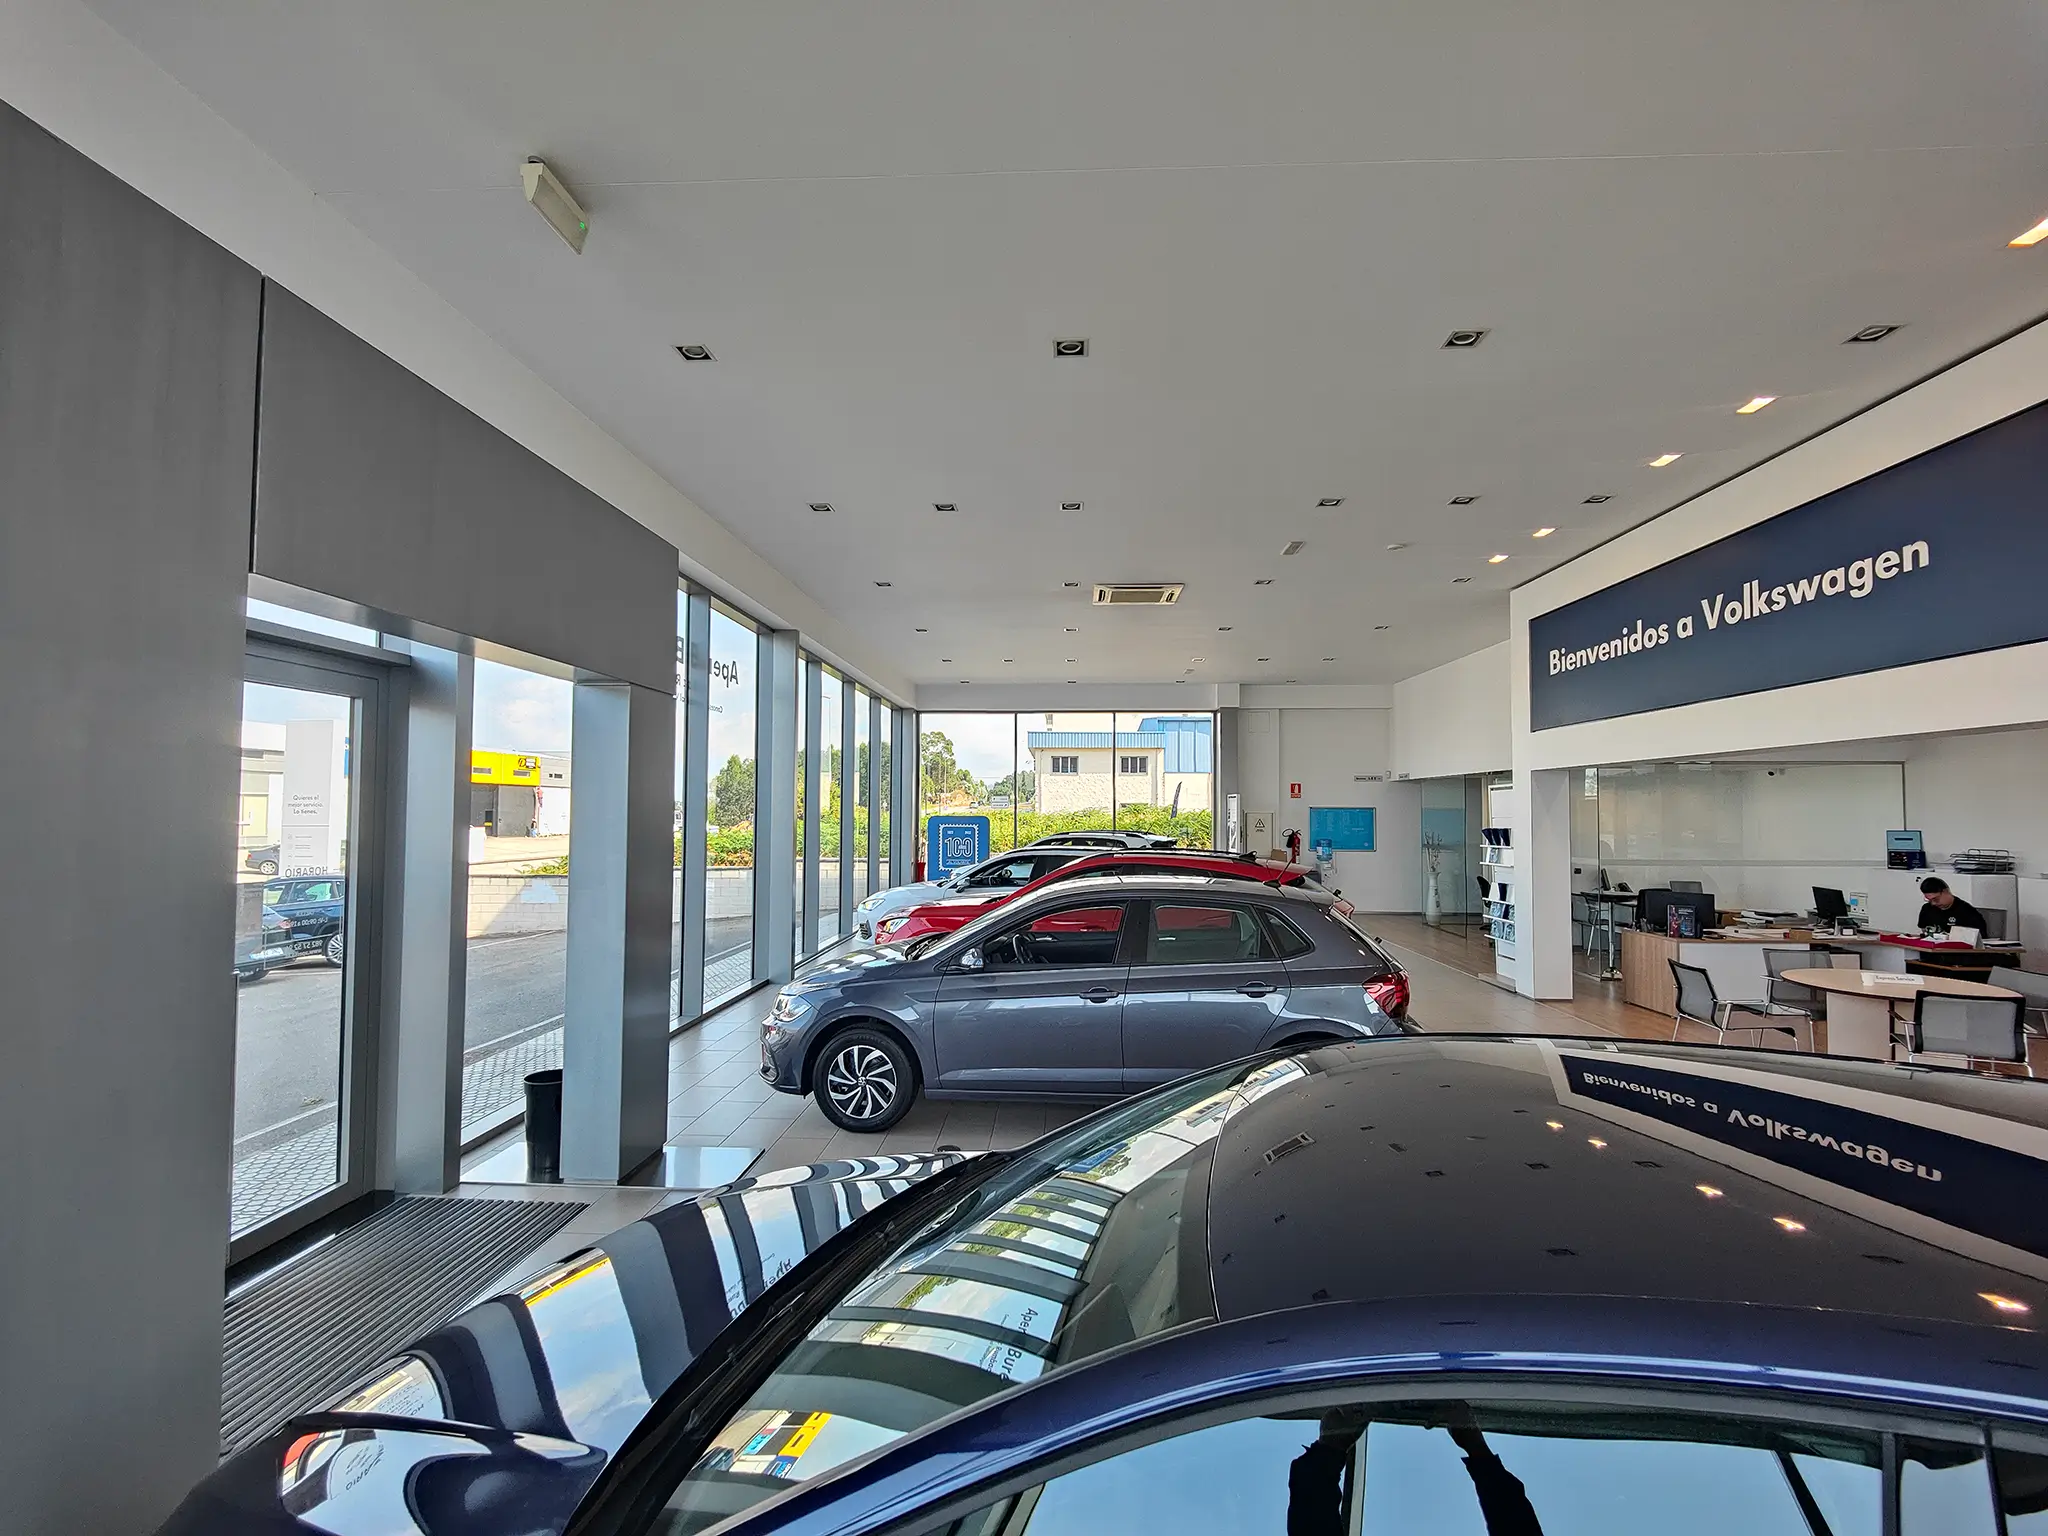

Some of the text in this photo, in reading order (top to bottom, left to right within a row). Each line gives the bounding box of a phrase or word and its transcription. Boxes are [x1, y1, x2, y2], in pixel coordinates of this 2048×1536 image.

[1549, 539, 1930, 676] Bienvenidos a Volkswagen
[945, 837, 973, 857] 100
